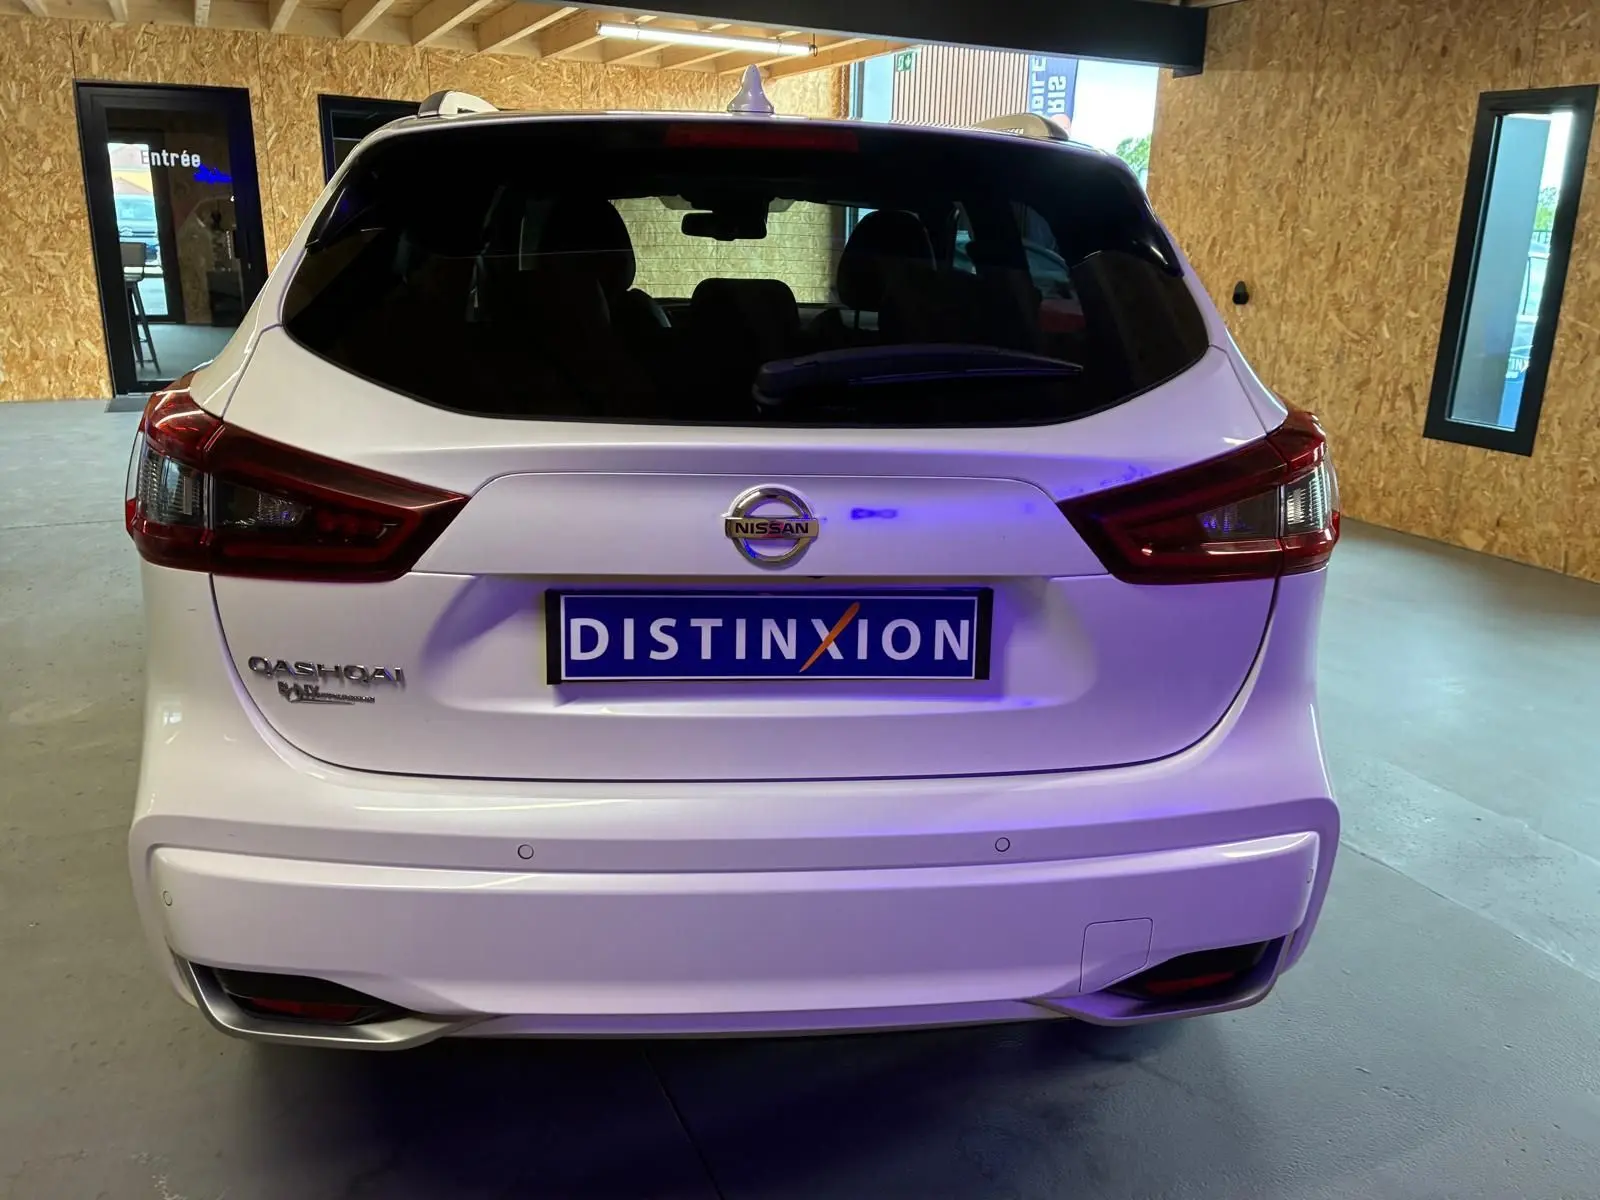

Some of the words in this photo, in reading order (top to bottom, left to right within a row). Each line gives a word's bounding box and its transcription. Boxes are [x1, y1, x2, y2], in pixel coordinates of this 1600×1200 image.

[141, 149, 201, 167] Entrée
[735, 522, 809, 535] NISSAN
[569, 604, 970, 671] DISTINXION
[248, 656, 405, 685] QASHQAI
